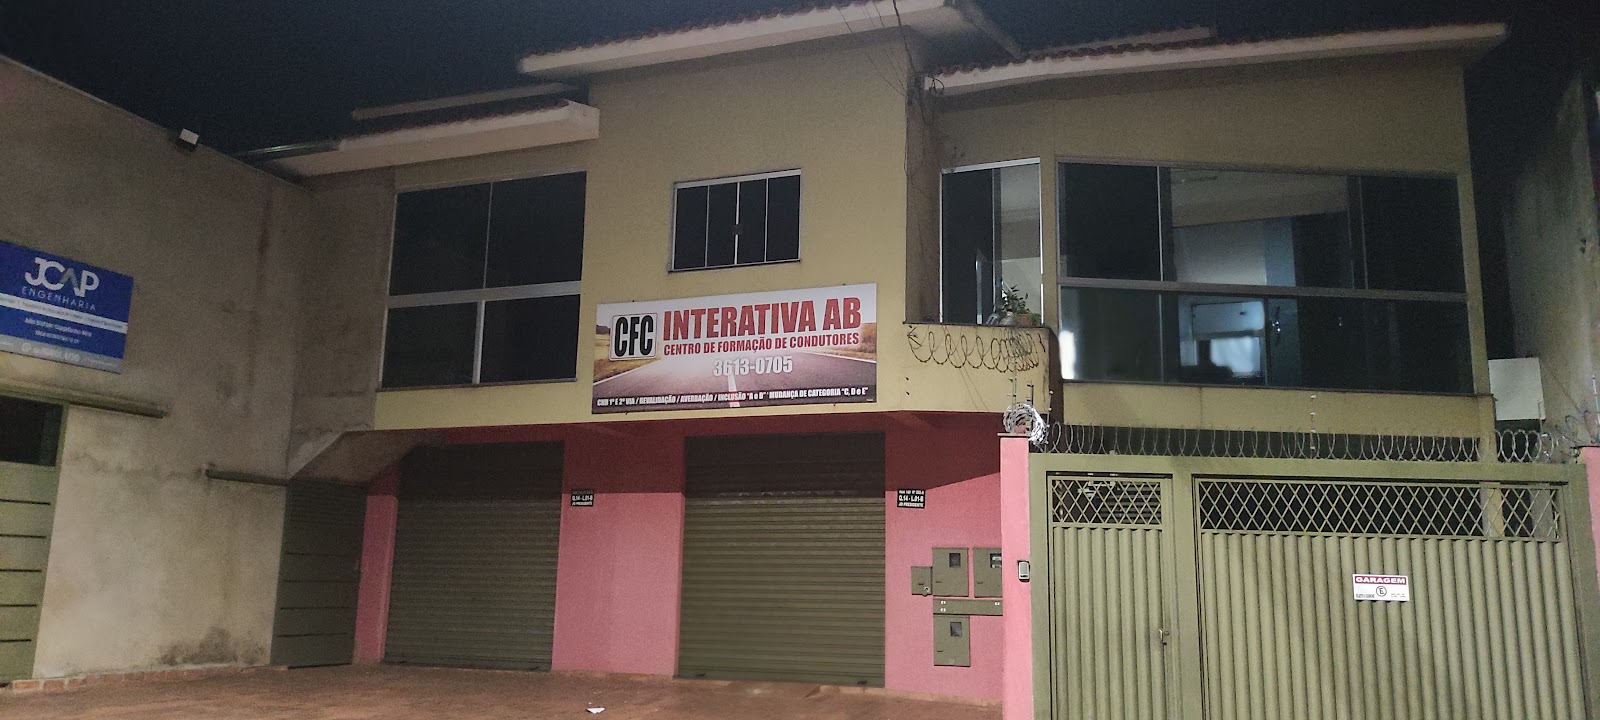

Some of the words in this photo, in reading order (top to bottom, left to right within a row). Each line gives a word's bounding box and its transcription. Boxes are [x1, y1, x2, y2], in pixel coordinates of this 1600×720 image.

[24, 257, 100, 297] JCAP
[21, 286, 97, 311] ENGENHARIA
[663, 300, 816, 341] INTERATIVA
[822, 297, 861, 330] AB
[614, 315, 654, 357] CFC
[664, 342, 701, 355] CENTRO
[704, 342, 715, 353] DE
[717, 336, 772, 353] FORMAÇÃO
[775, 337, 787, 349] DE
[789, 332, 859, 348] CONDUTORES
[713, 355, 793, 376] 3613-0705
[625, 397, 635, 405] VIA
[639, 394, 676, 405] REVALIDAÇÃO
[680, 393, 713, 403] AVERBAÇÃO
[717, 391, 746, 401] INCLUSÃO
[769, 389, 798, 399] MUDANÇA
[800, 389, 807, 397] DE
[808, 387, 841, 398] CATEGORIA
[851, 387, 856, 395] D
